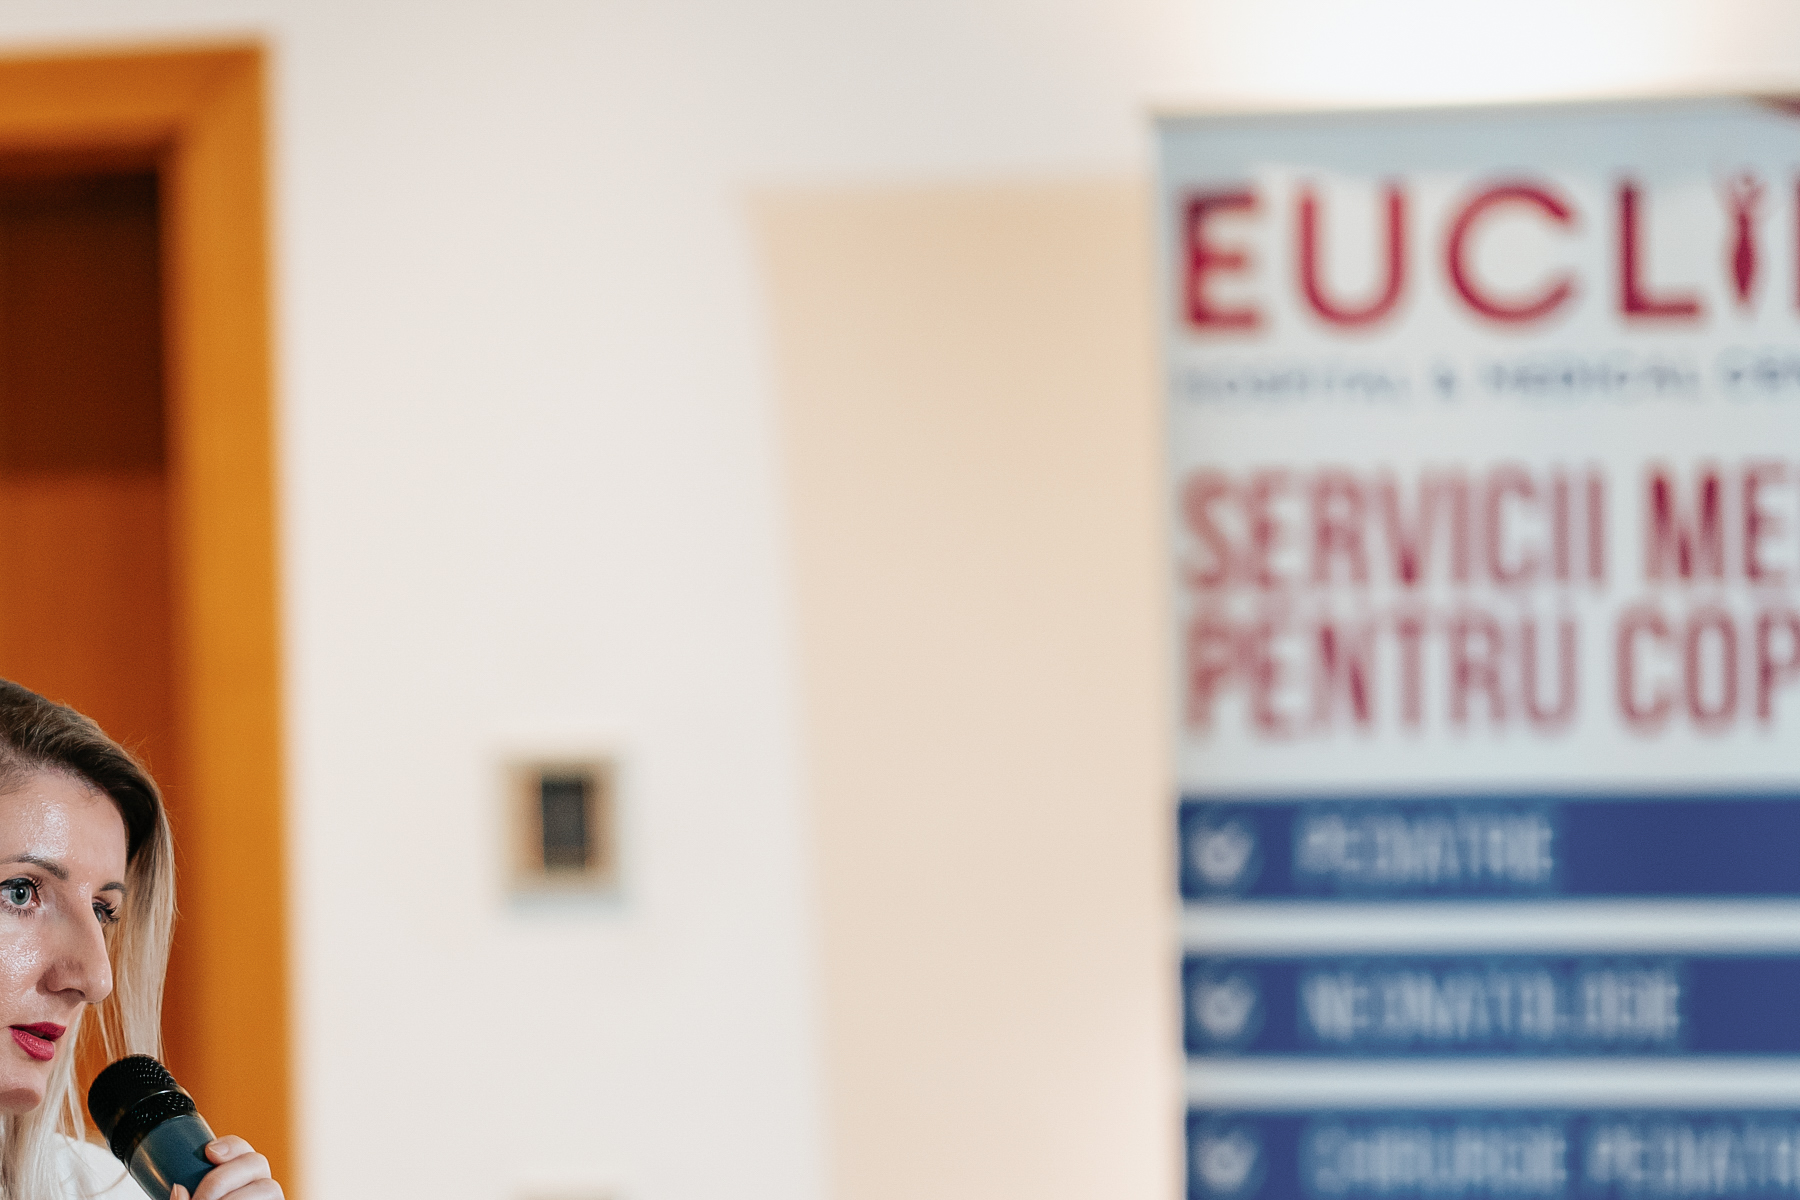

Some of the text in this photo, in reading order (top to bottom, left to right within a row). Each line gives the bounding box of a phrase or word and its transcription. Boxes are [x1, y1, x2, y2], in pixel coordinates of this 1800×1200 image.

[1182, 168, 1800, 334] EUCLI
[1184, 464, 1608, 592] SERVICII
[1186, 602, 1582, 736] PENTRU
